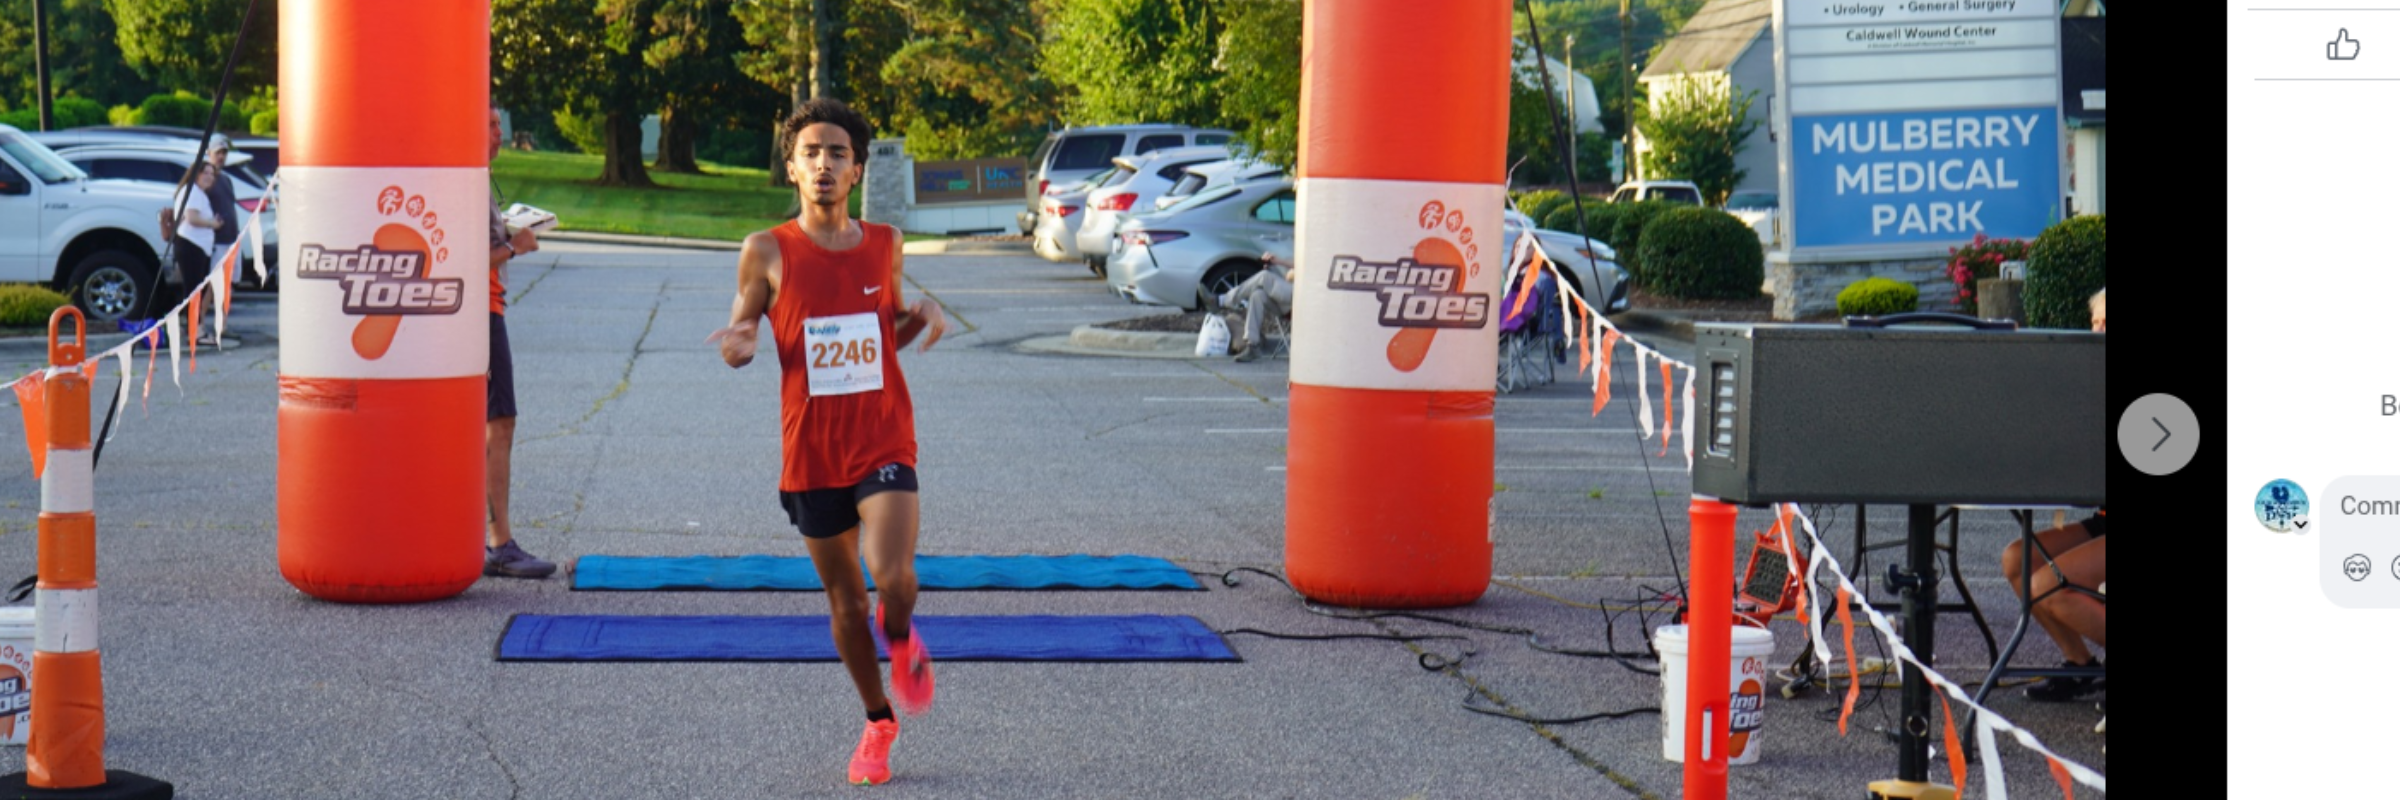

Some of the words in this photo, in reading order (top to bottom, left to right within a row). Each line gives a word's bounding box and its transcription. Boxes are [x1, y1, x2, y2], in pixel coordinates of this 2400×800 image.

[1832, 3, 1884, 17] Urology
[1908, 0, 1959, 12] General
[1964, 0, 2016, 12] Surgery
[1846, 28, 1901, 41] Caldwell
[1905, 27, 1951, 39] Wound
[1954, 26, 1997, 37] Center
[1812, 114, 2040, 155] MULBERRY
[1835, 158, 2019, 195] MEDICAL
[1872, 200, 1985, 236] PARK
[300, 247, 419, 279] Racing
[1331, 257, 1455, 292] Racing
[344, 273, 460, 308] Toes
[1382, 287, 1488, 321] Toes
[811, 337, 877, 369] 2246
